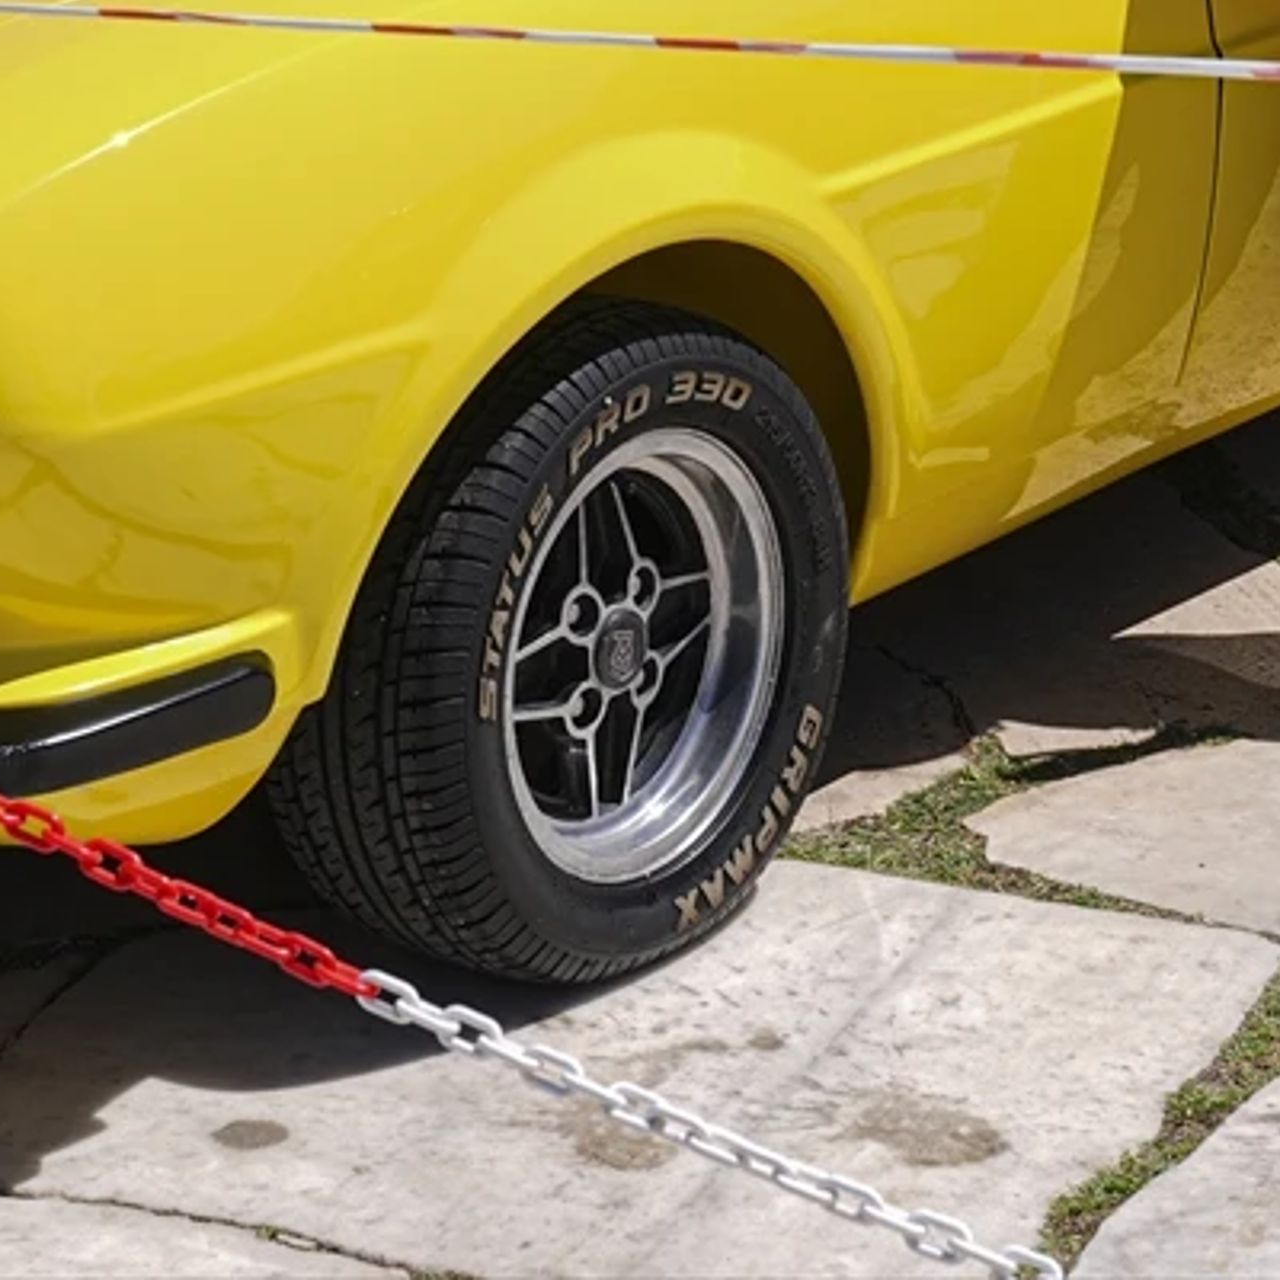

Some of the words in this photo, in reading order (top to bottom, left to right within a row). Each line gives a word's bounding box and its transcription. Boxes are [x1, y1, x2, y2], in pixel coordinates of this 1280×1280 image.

[479, 483, 554, 721] STATUS
[570, 384, 651, 475] PRO
[666, 371, 753, 411] 330
[673, 704, 823, 933] GRIPMAX
